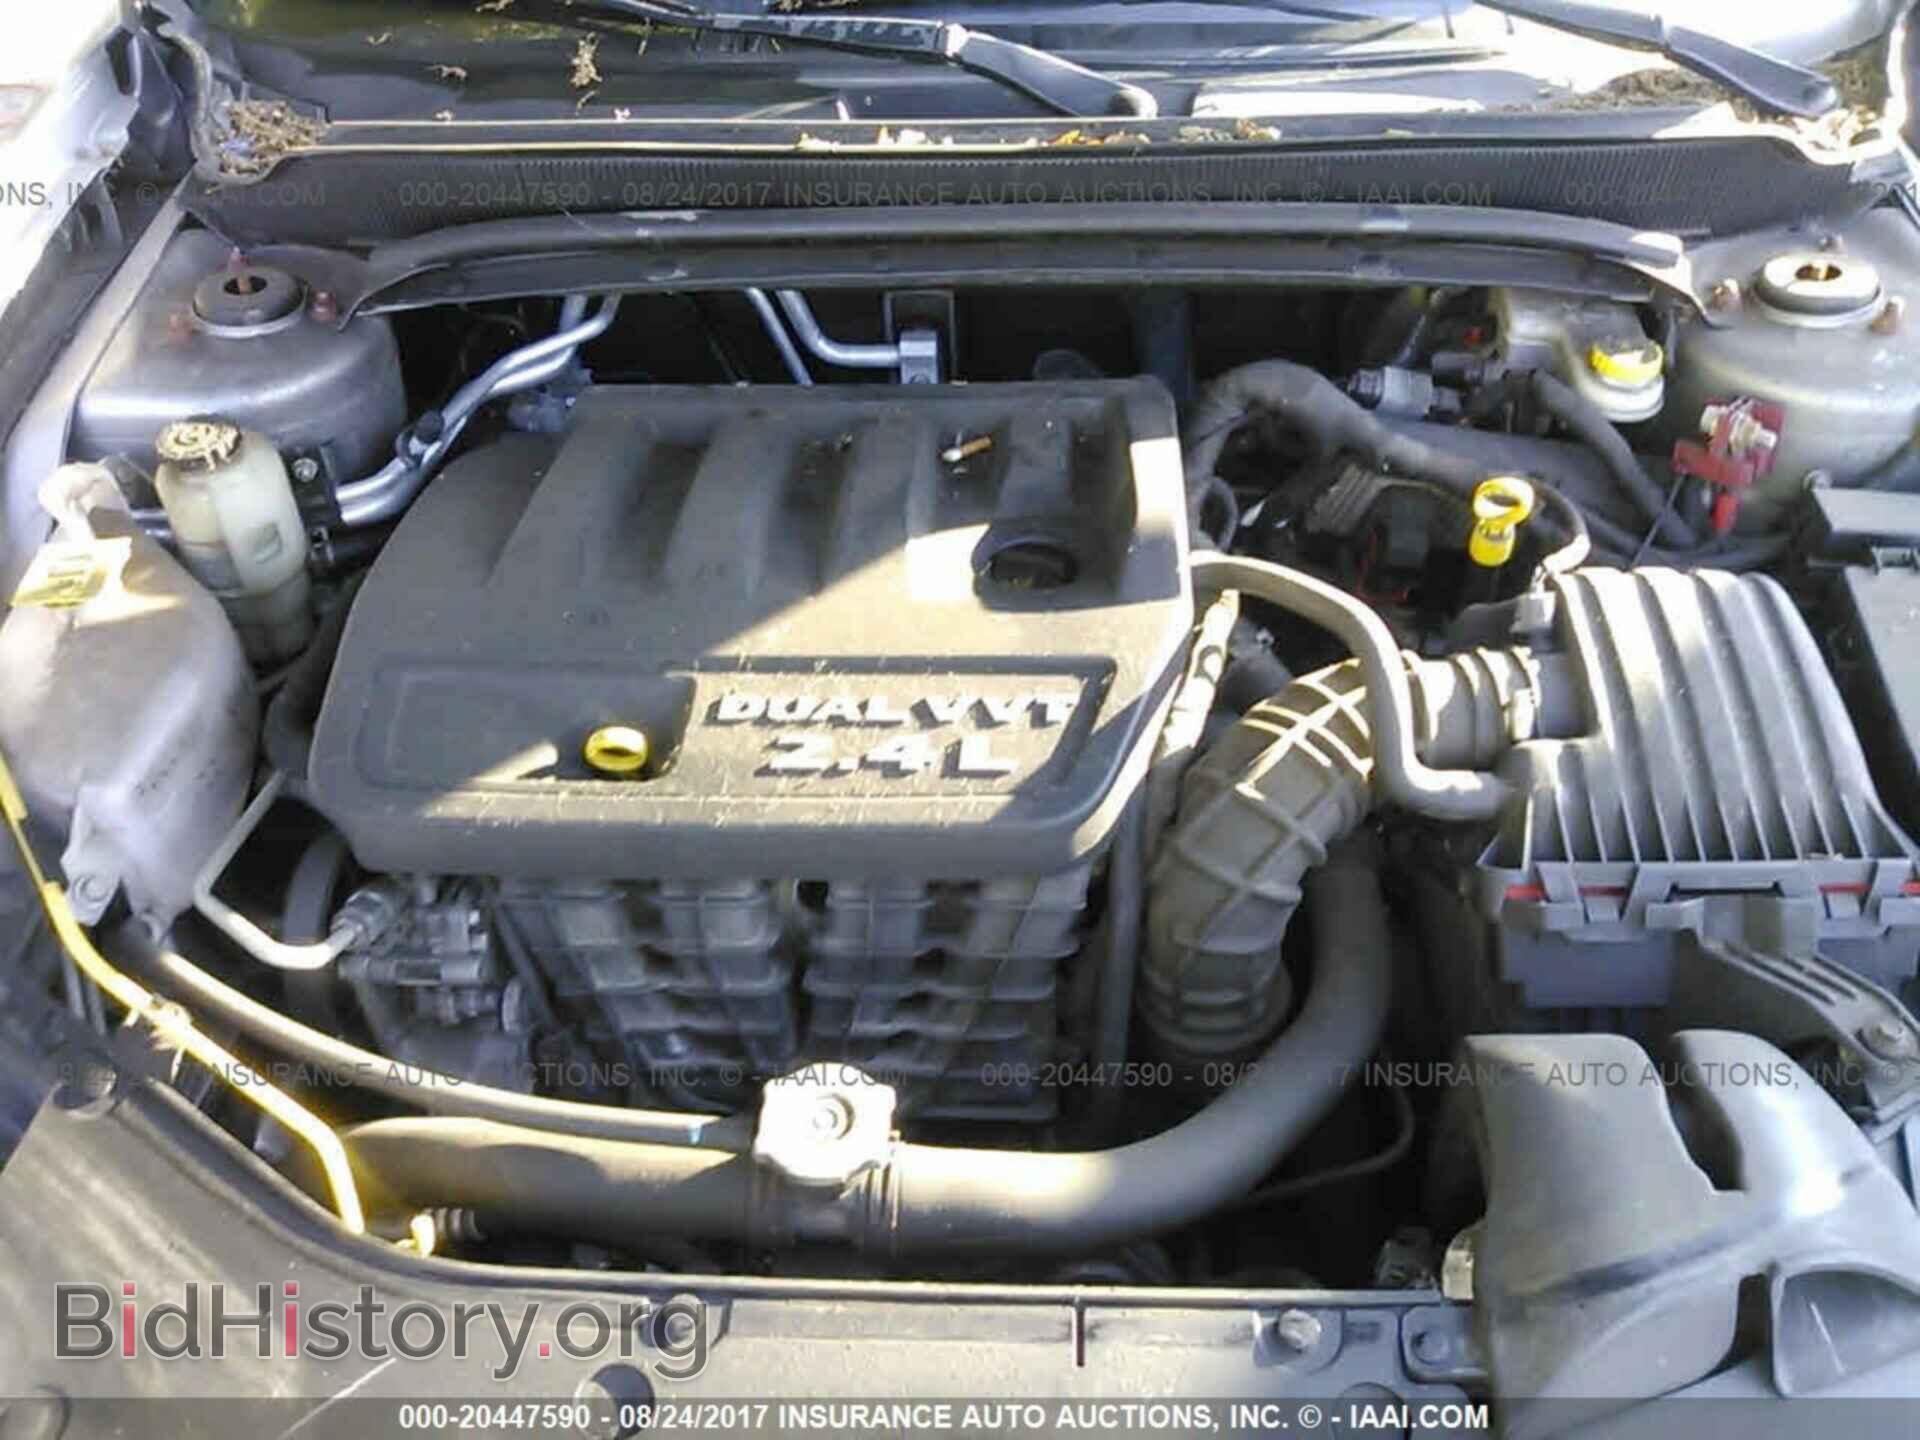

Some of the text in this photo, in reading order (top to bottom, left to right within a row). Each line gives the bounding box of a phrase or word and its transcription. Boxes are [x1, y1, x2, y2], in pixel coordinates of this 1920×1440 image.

[704, 691, 1080, 728] DUAL VVT
[754, 733, 1020, 778] 2.4L
